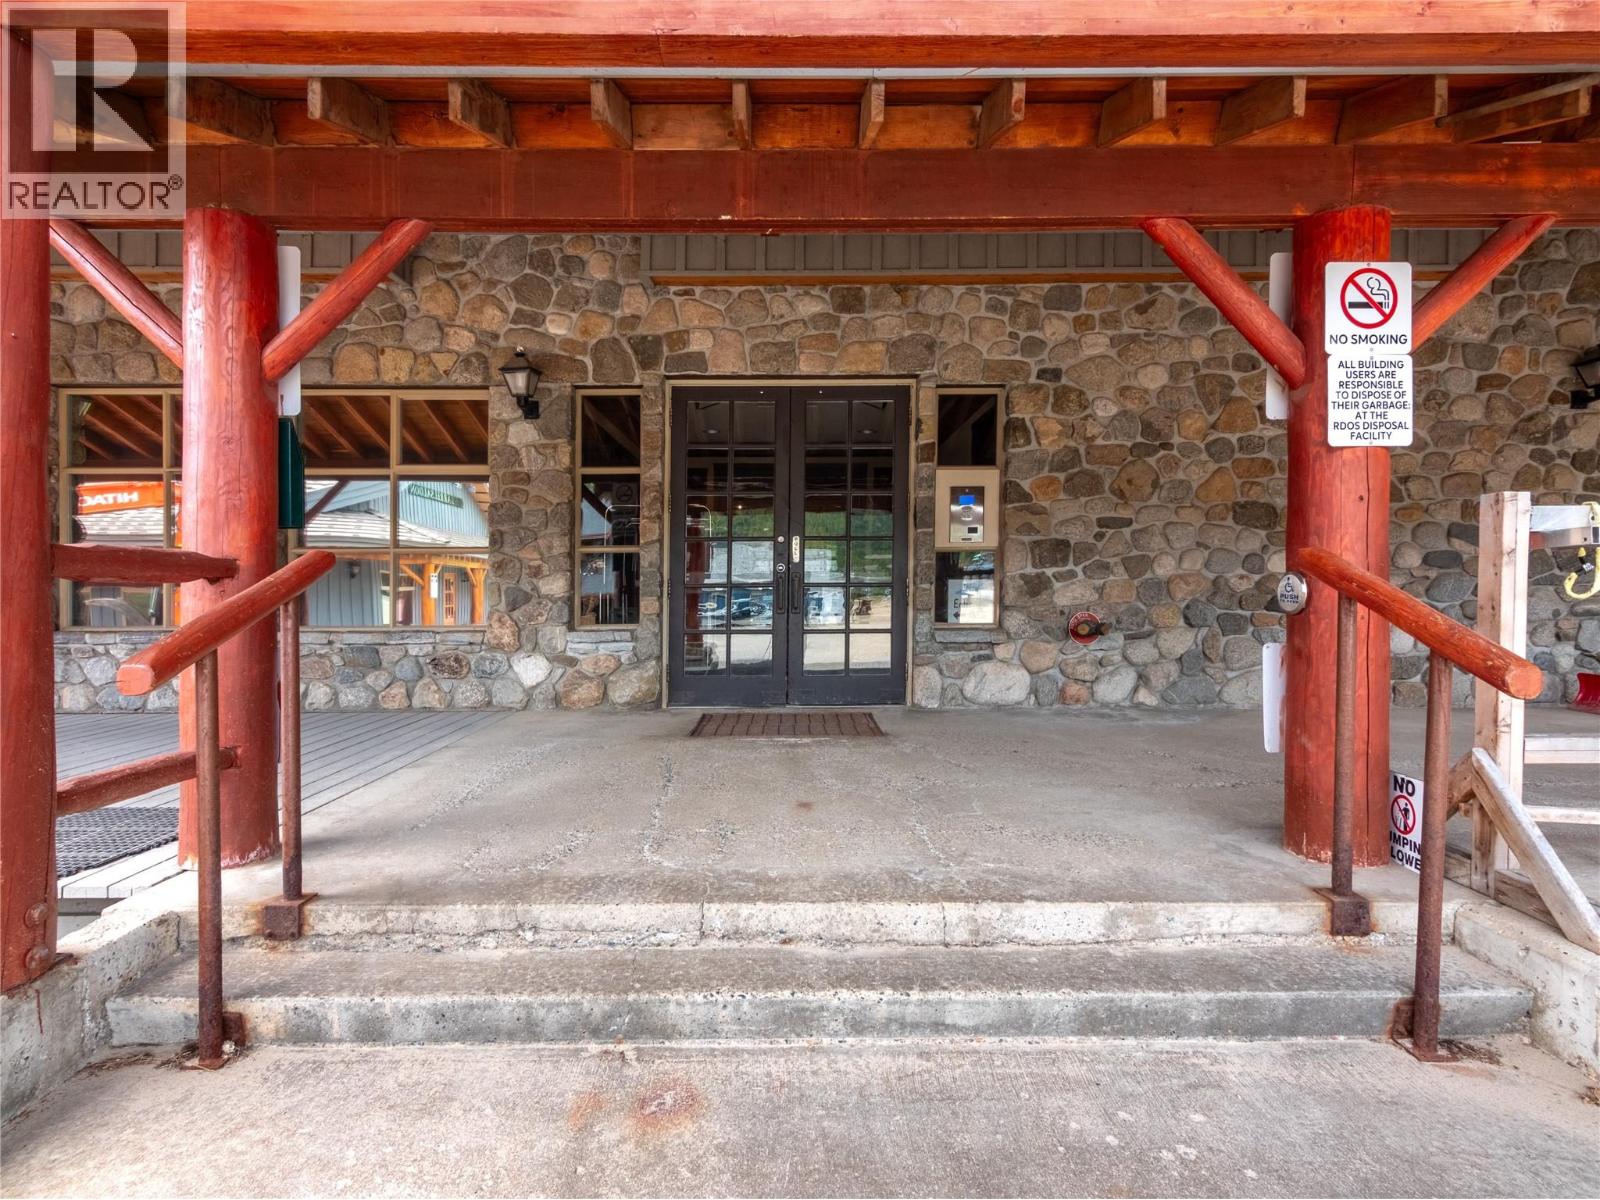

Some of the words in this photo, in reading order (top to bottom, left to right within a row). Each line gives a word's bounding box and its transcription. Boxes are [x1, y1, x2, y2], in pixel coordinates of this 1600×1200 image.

[1329, 334, 1348, 344] NO
[1351, 334, 1408, 344] SMOKING
[1338, 360, 1356, 369] ALL
[1358, 360, 1404, 369] BUILDING
[1345, 370, 1376, 379] USERS
[1378, 370, 1397, 379] ARE
[1338, 380, 1404, 389] RESPONSIBLE
[1336, 390, 1349, 399] TO
[1351, 390, 1392, 399] DISPOSE
[1394, 390, 1407, 399] OF
[1331, 401, 1360, 410] THEIR
[1355, 411, 1368, 420] AT
[1370, 411, 1389, 420] THE
[1333, 421, 1360, 430] RDOS
[1362, 421, 1409, 430] DISPOSAL
[1350, 431, 1392, 440] FACILITY
[1393, 775, 1416, 797] NO
[1389, 830, 1421, 856] MPIN
[1390, 846, 1421, 871] LOWE
